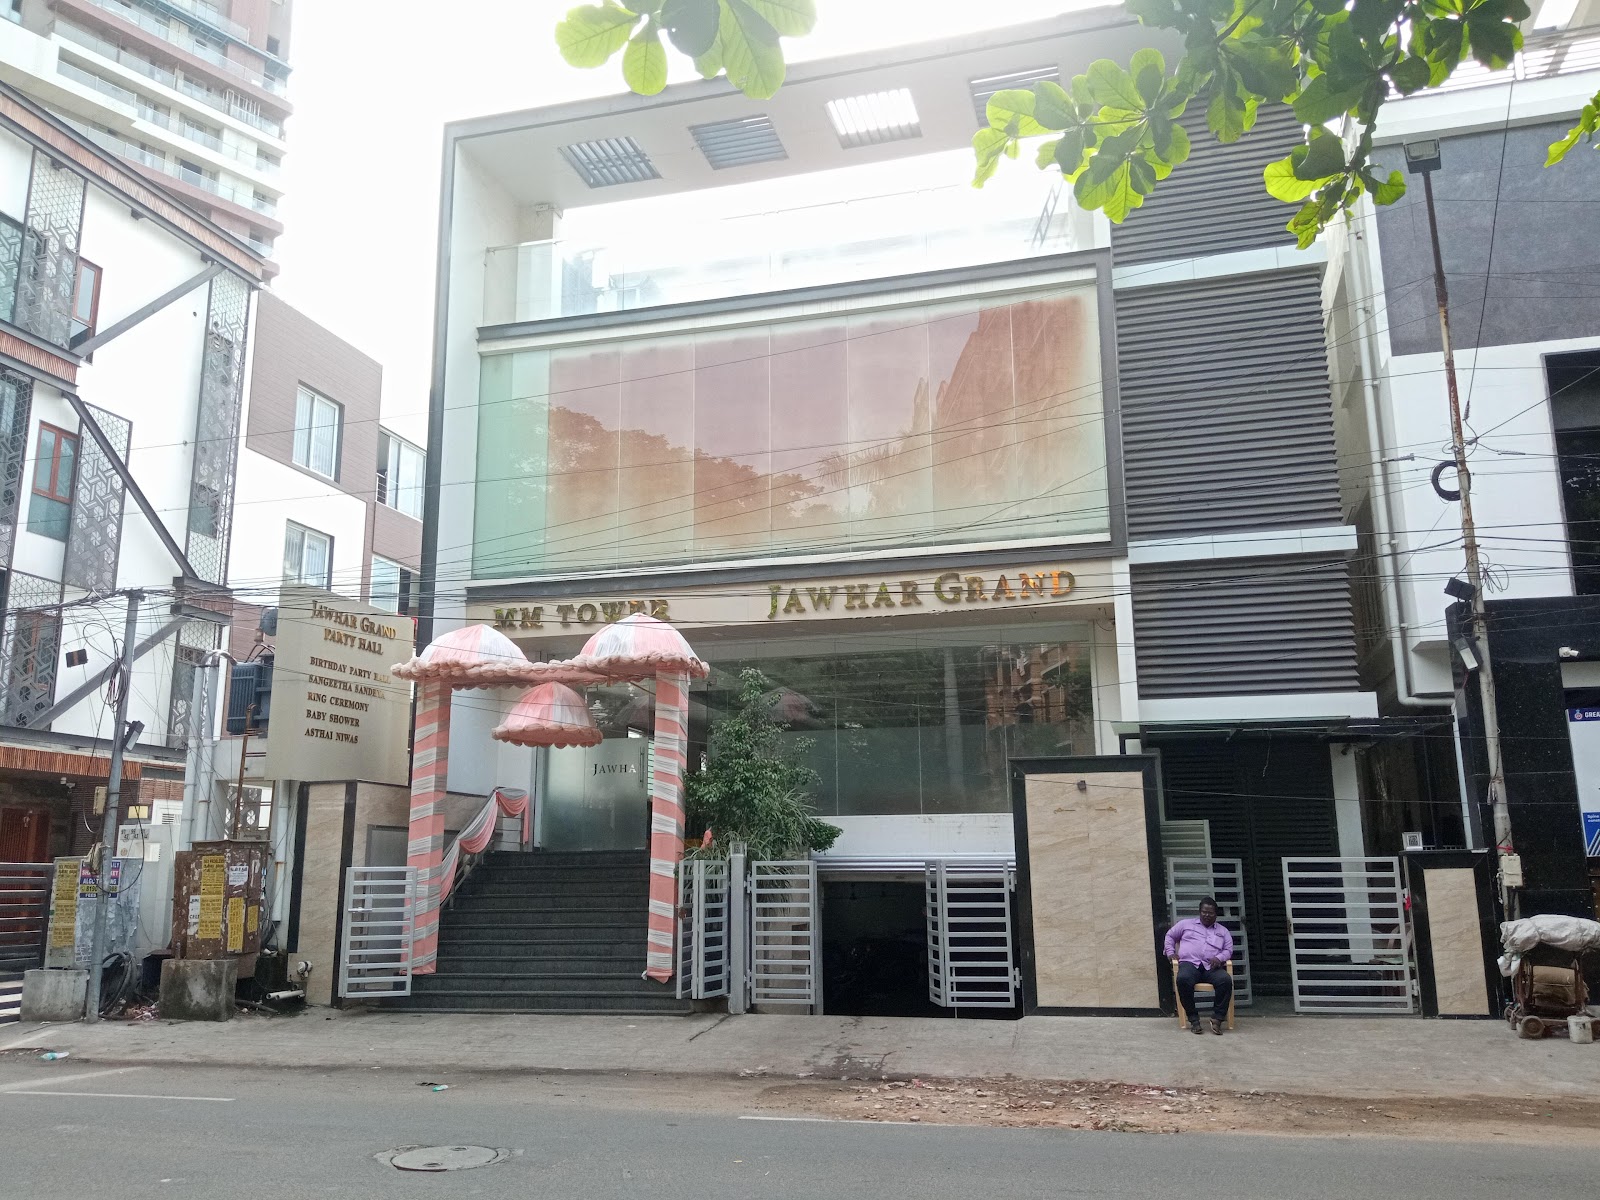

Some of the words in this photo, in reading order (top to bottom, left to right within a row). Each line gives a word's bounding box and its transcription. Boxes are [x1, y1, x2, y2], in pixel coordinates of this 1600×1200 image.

[767, 580, 922, 619] JAWHAR
[933, 570, 1076, 604] GRAND
[310, 600, 358, 629] JAWHAR
[360, 617, 397, 640] GRAND
[492, 606, 544, 630] MM
[556, 600, 671, 627] TOWER
[323, 628, 357, 648] PARTY
[358, 637, 384, 656] HALL
[309, 656, 348, 673] BIRTHDAY
[349, 666, 372, 680] PARTY
[308, 674, 353, 692] SANGEETHA
[307, 691, 327, 704] RING
[329, 696, 370, 712] CEREMONY
[306, 709, 327, 721] BABY
[329, 713, 360, 728] SHOWER
[304, 727, 333, 740] ASTHAI
[335, 732, 359, 744] NIWAS
